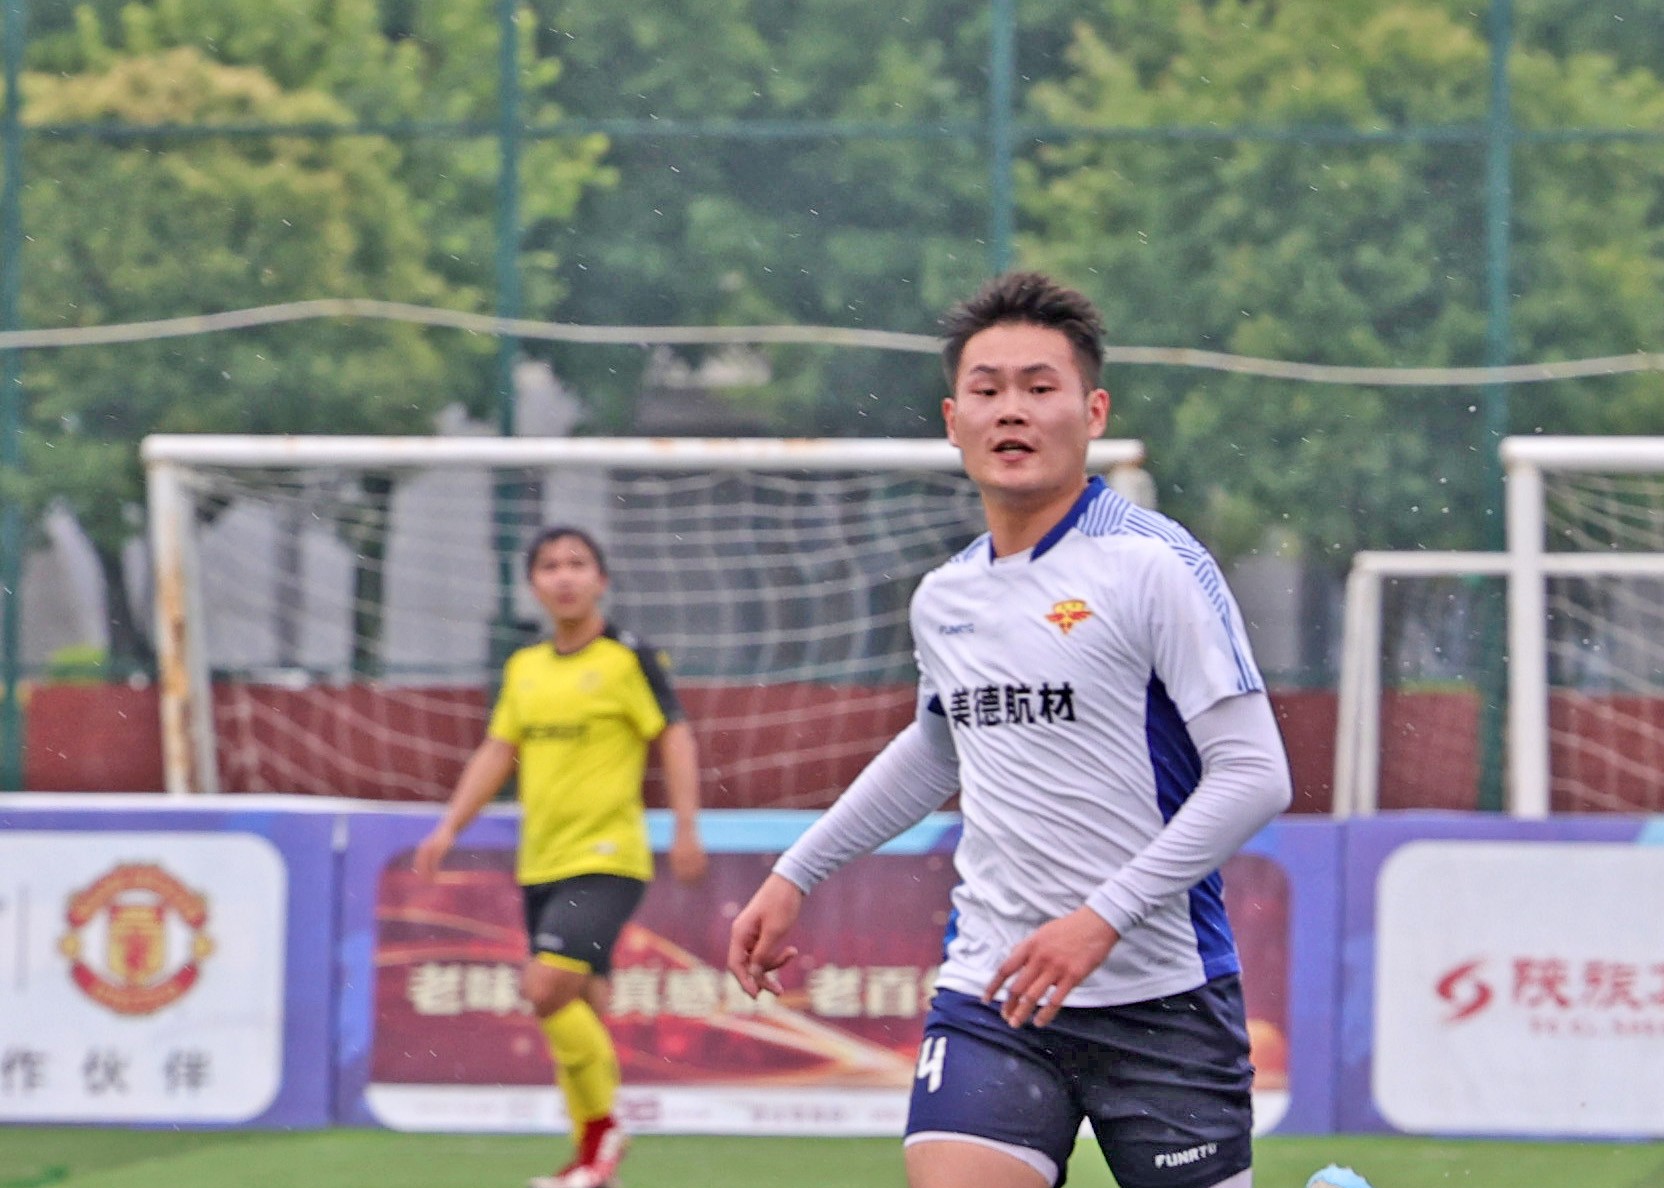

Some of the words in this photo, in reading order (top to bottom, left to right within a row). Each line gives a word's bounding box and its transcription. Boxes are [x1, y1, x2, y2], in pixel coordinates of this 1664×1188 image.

[950, 681, 1076, 729] 美德航材
[409, 963, 534, 1016] 老味
[809, 965, 939, 1016] 老百
[917, 1036, 947, 1093] 4
